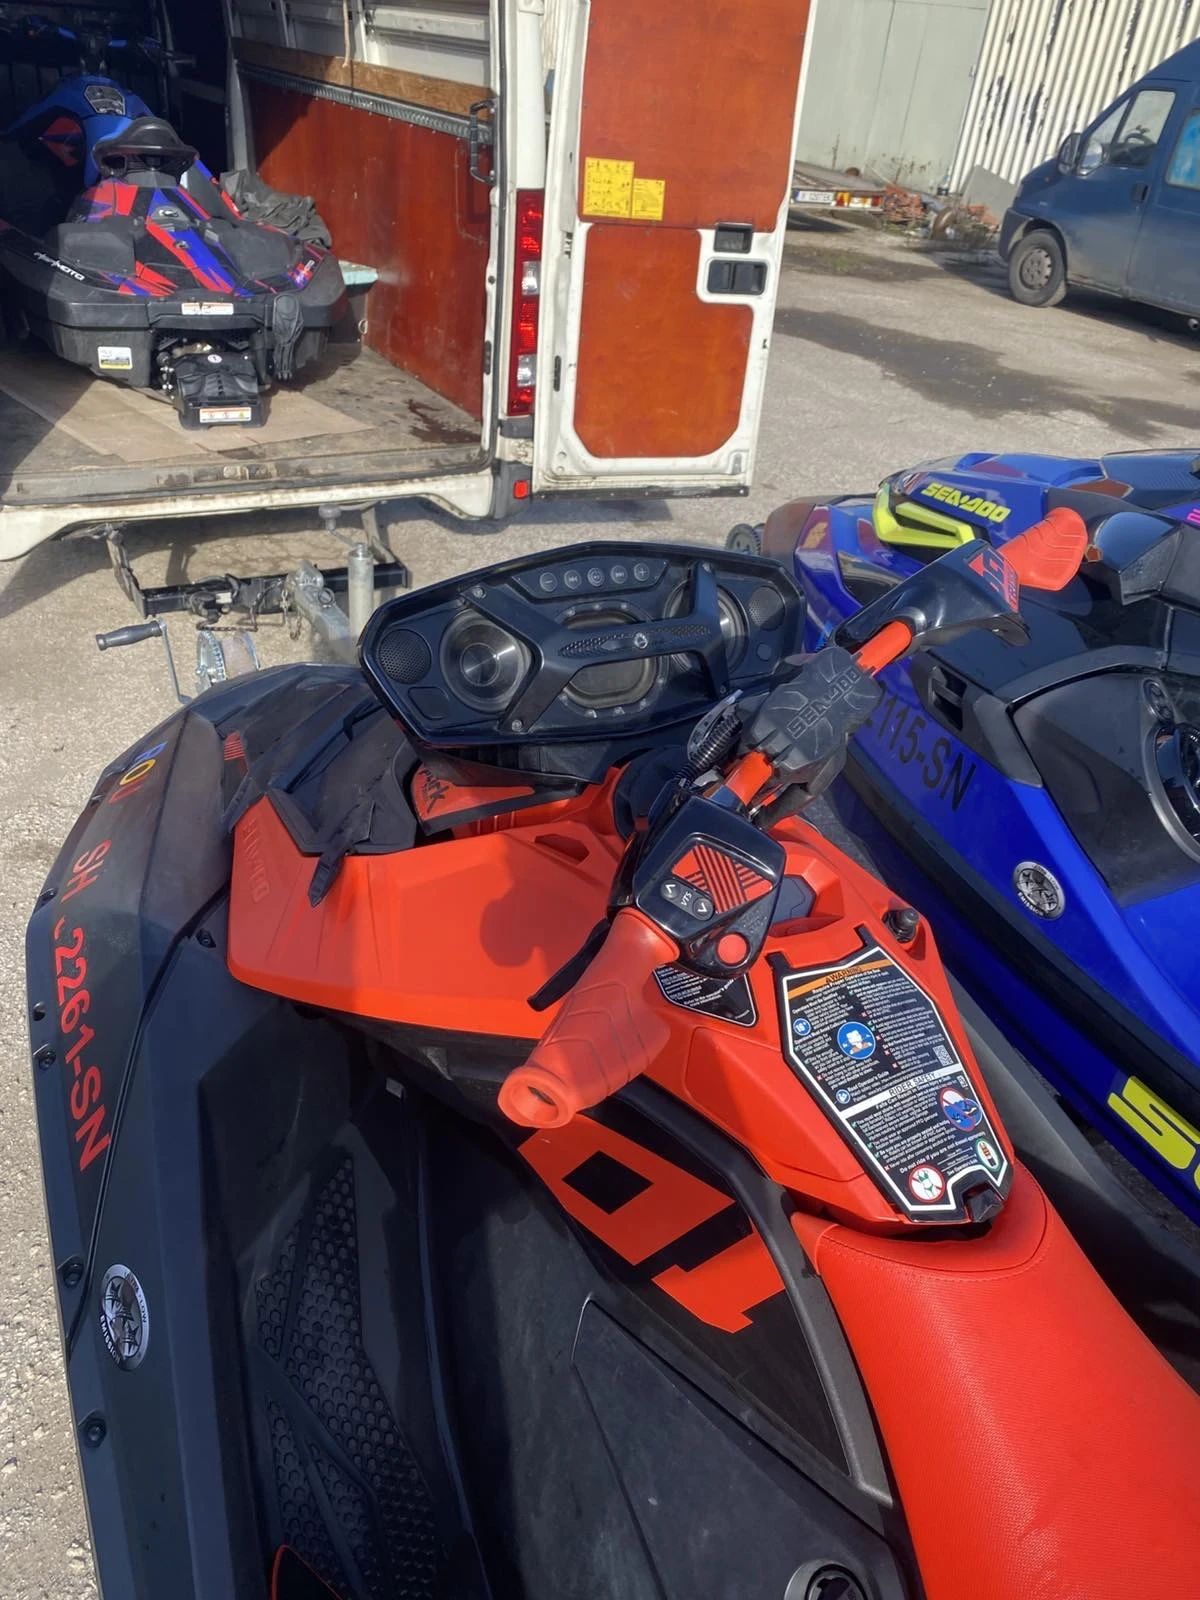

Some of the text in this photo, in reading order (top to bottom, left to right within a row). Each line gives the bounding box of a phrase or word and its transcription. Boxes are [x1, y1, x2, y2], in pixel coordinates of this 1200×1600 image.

[681, 890, 692, 906] VTS
[828, 966, 862, 981] WARNING
[888, 1080, 914, 1097] RIDER
[913, 1070, 936, 1086] SAFETY
[100, 1314, 121, 1364] EMISSION
